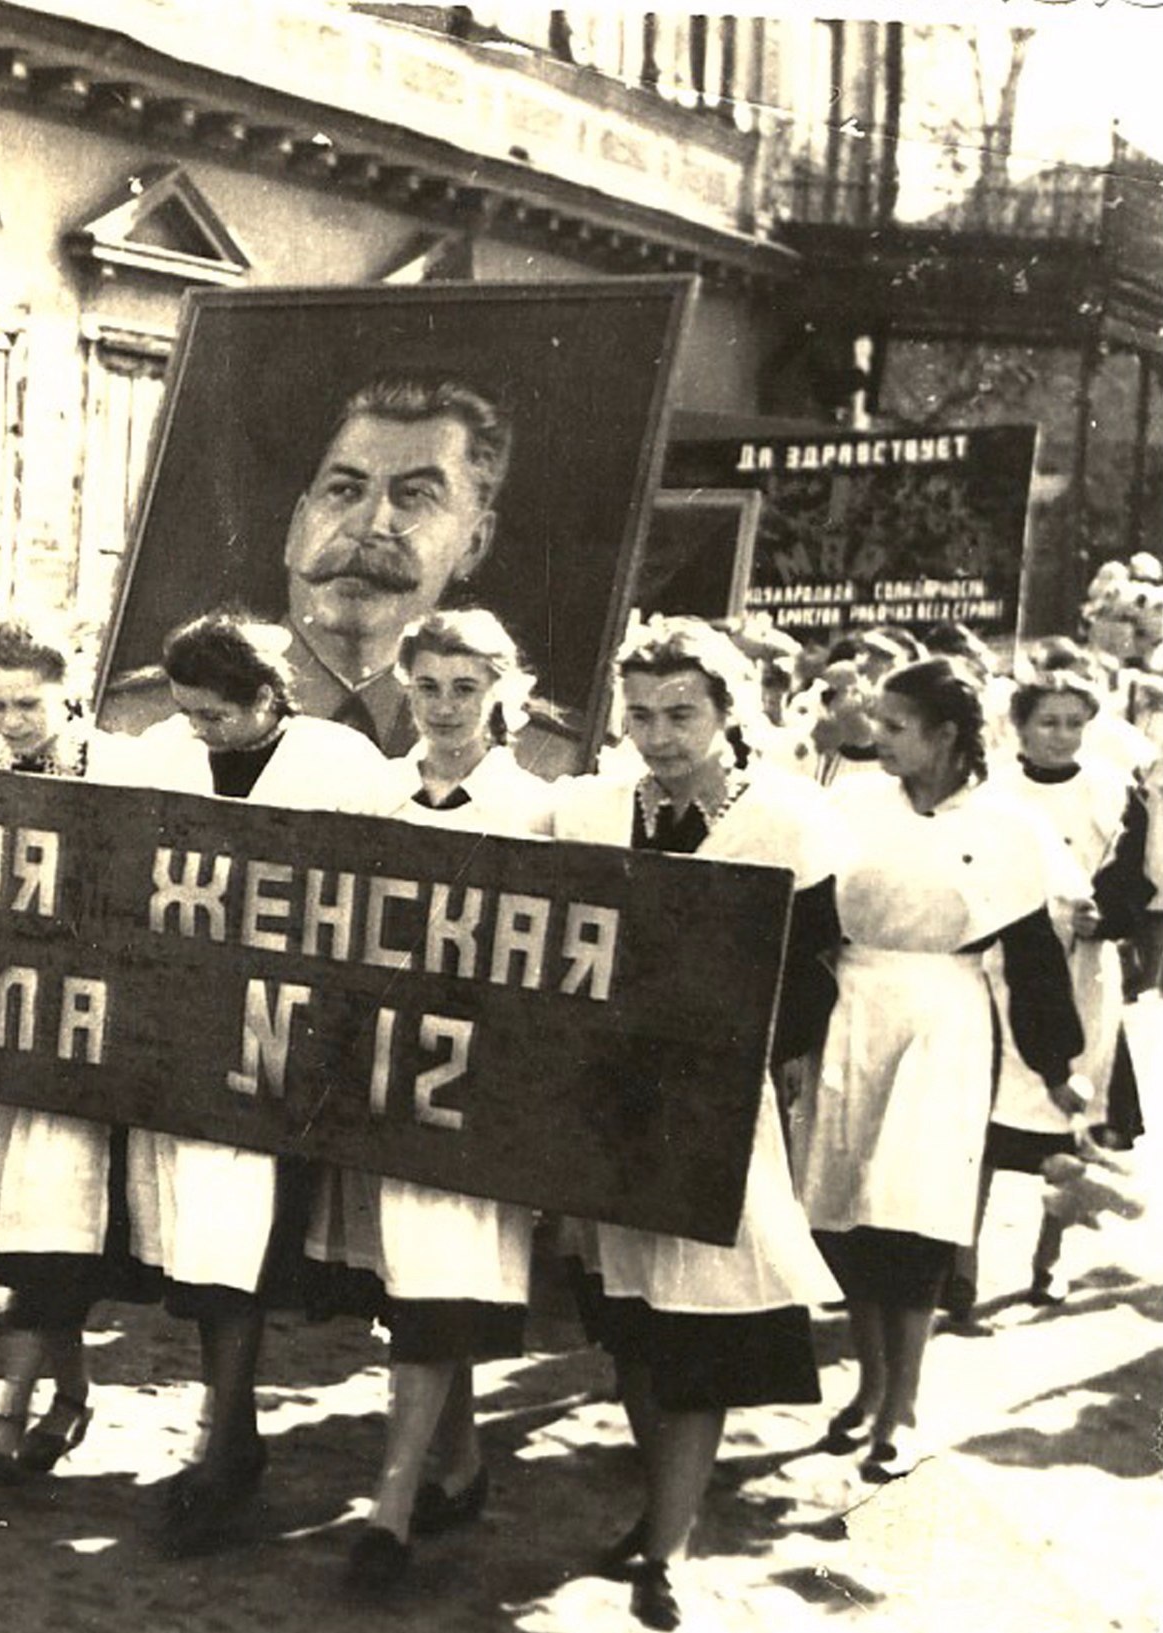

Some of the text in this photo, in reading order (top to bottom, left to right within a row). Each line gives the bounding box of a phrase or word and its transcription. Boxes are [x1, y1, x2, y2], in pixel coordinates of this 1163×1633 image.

[737, 435, 967, 469] ДА ЗДРАВСТВУЕТ
[149, 846, 620, 1000] ЖЕНСКАЯ
[370, 1007, 474, 1130] 12
